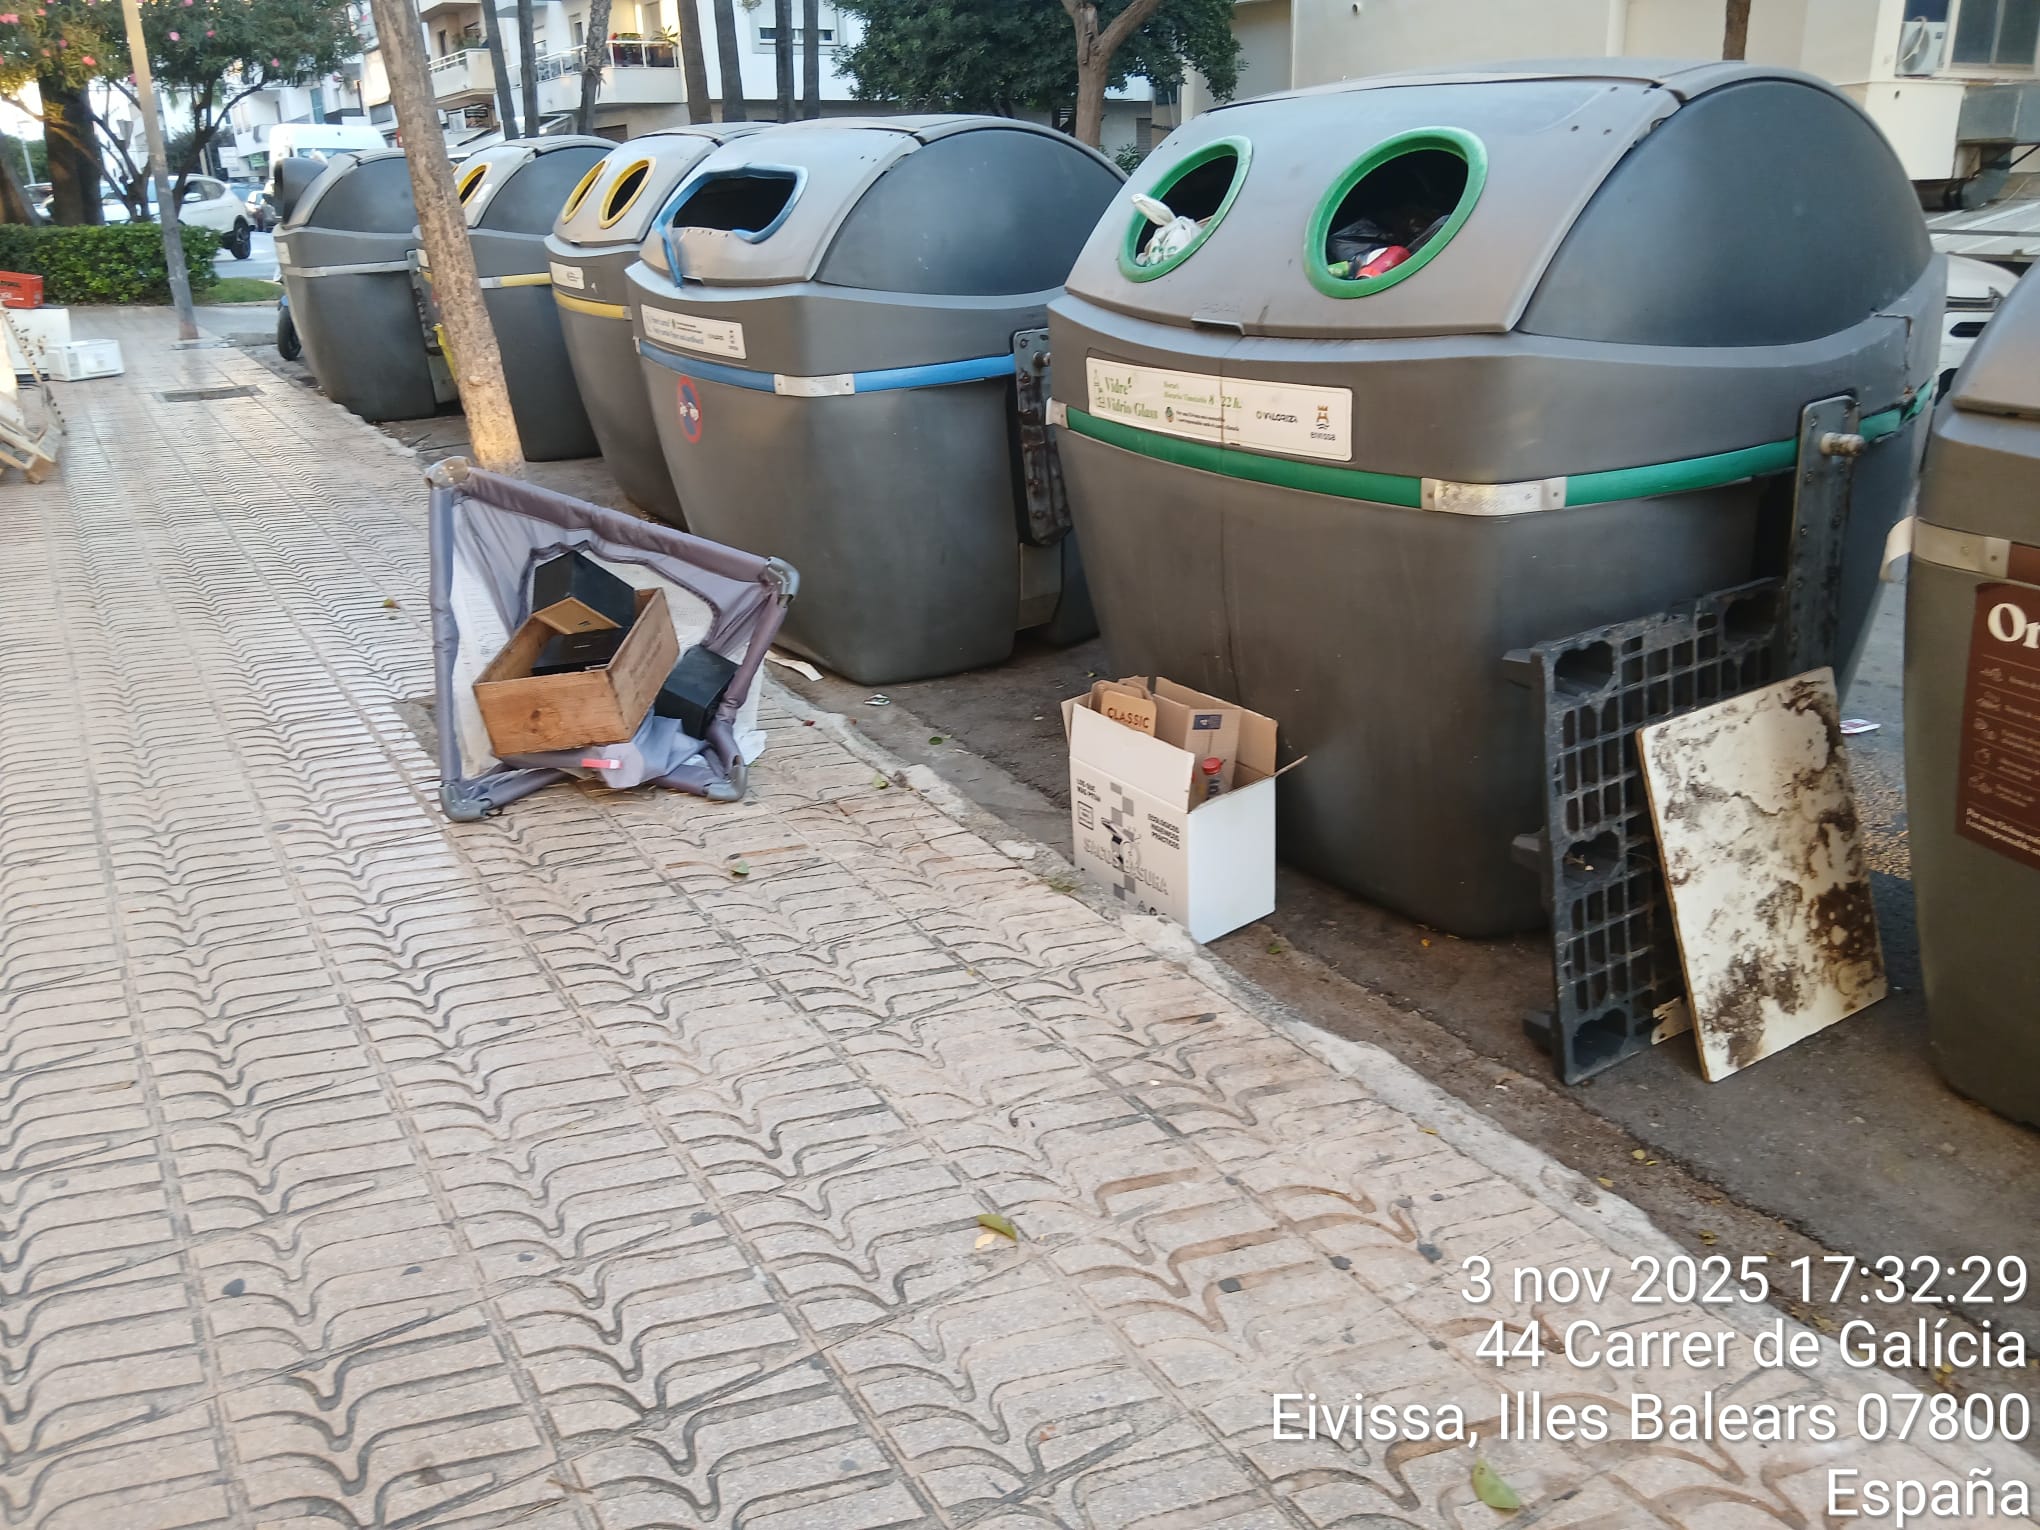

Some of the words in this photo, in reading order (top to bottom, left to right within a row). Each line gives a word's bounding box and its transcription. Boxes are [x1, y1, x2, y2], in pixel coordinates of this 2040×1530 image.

[1106, 396, 1132, 415] Vidrio
[1134, 401, 1158, 419] Glass
[1106, 706, 1150, 730] CLASSIC
